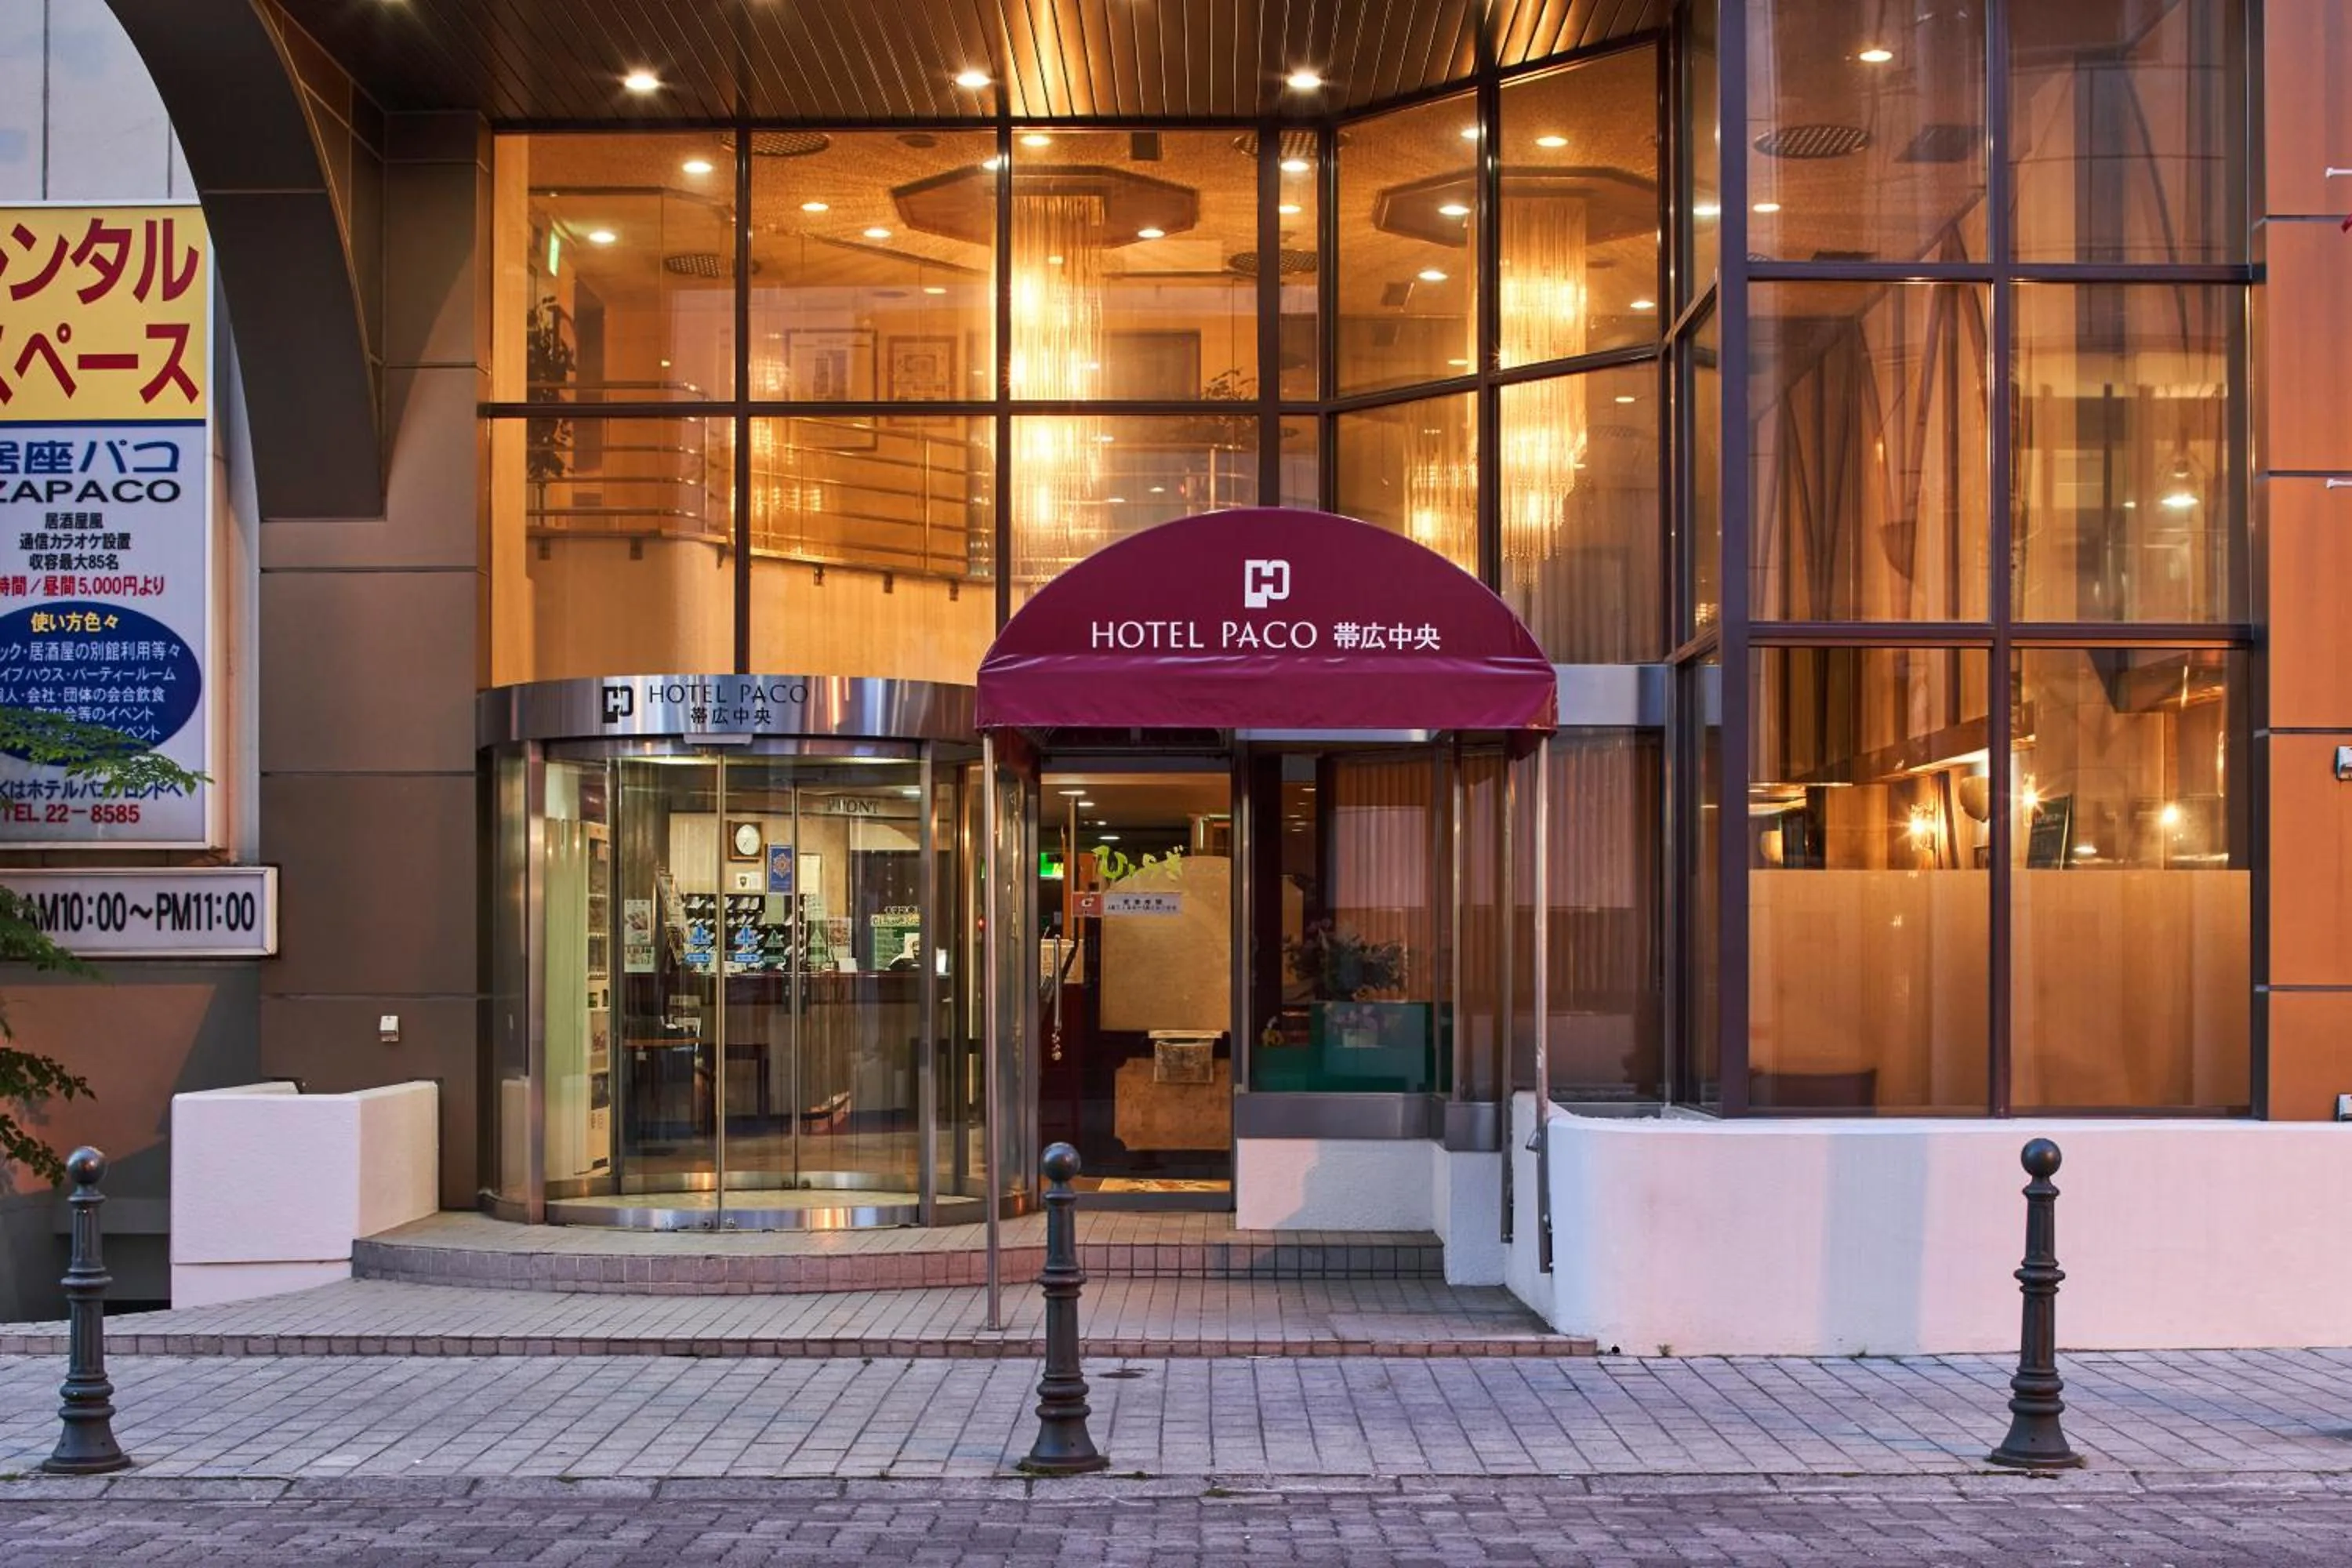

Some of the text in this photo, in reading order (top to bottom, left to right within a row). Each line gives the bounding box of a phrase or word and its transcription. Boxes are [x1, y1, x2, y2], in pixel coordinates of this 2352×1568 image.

[0, 217, 199, 305] ンタル
[0, 322, 199, 405] ペース
[45, 512, 104, 530] 居酒屋風
[20, 532, 132, 550] 通信カラオケ設置
[29, 554, 120, 571] 収容最大85名
[31, 612, 119, 633] 使い方色々
[1091, 621, 1441, 651] HOTEL PACO 帯広中央
[649, 684, 808, 703] HOTEL PACO
[34, 706, 155, 723] 会等のイベント
[691, 706, 771, 725] 帯広中央
